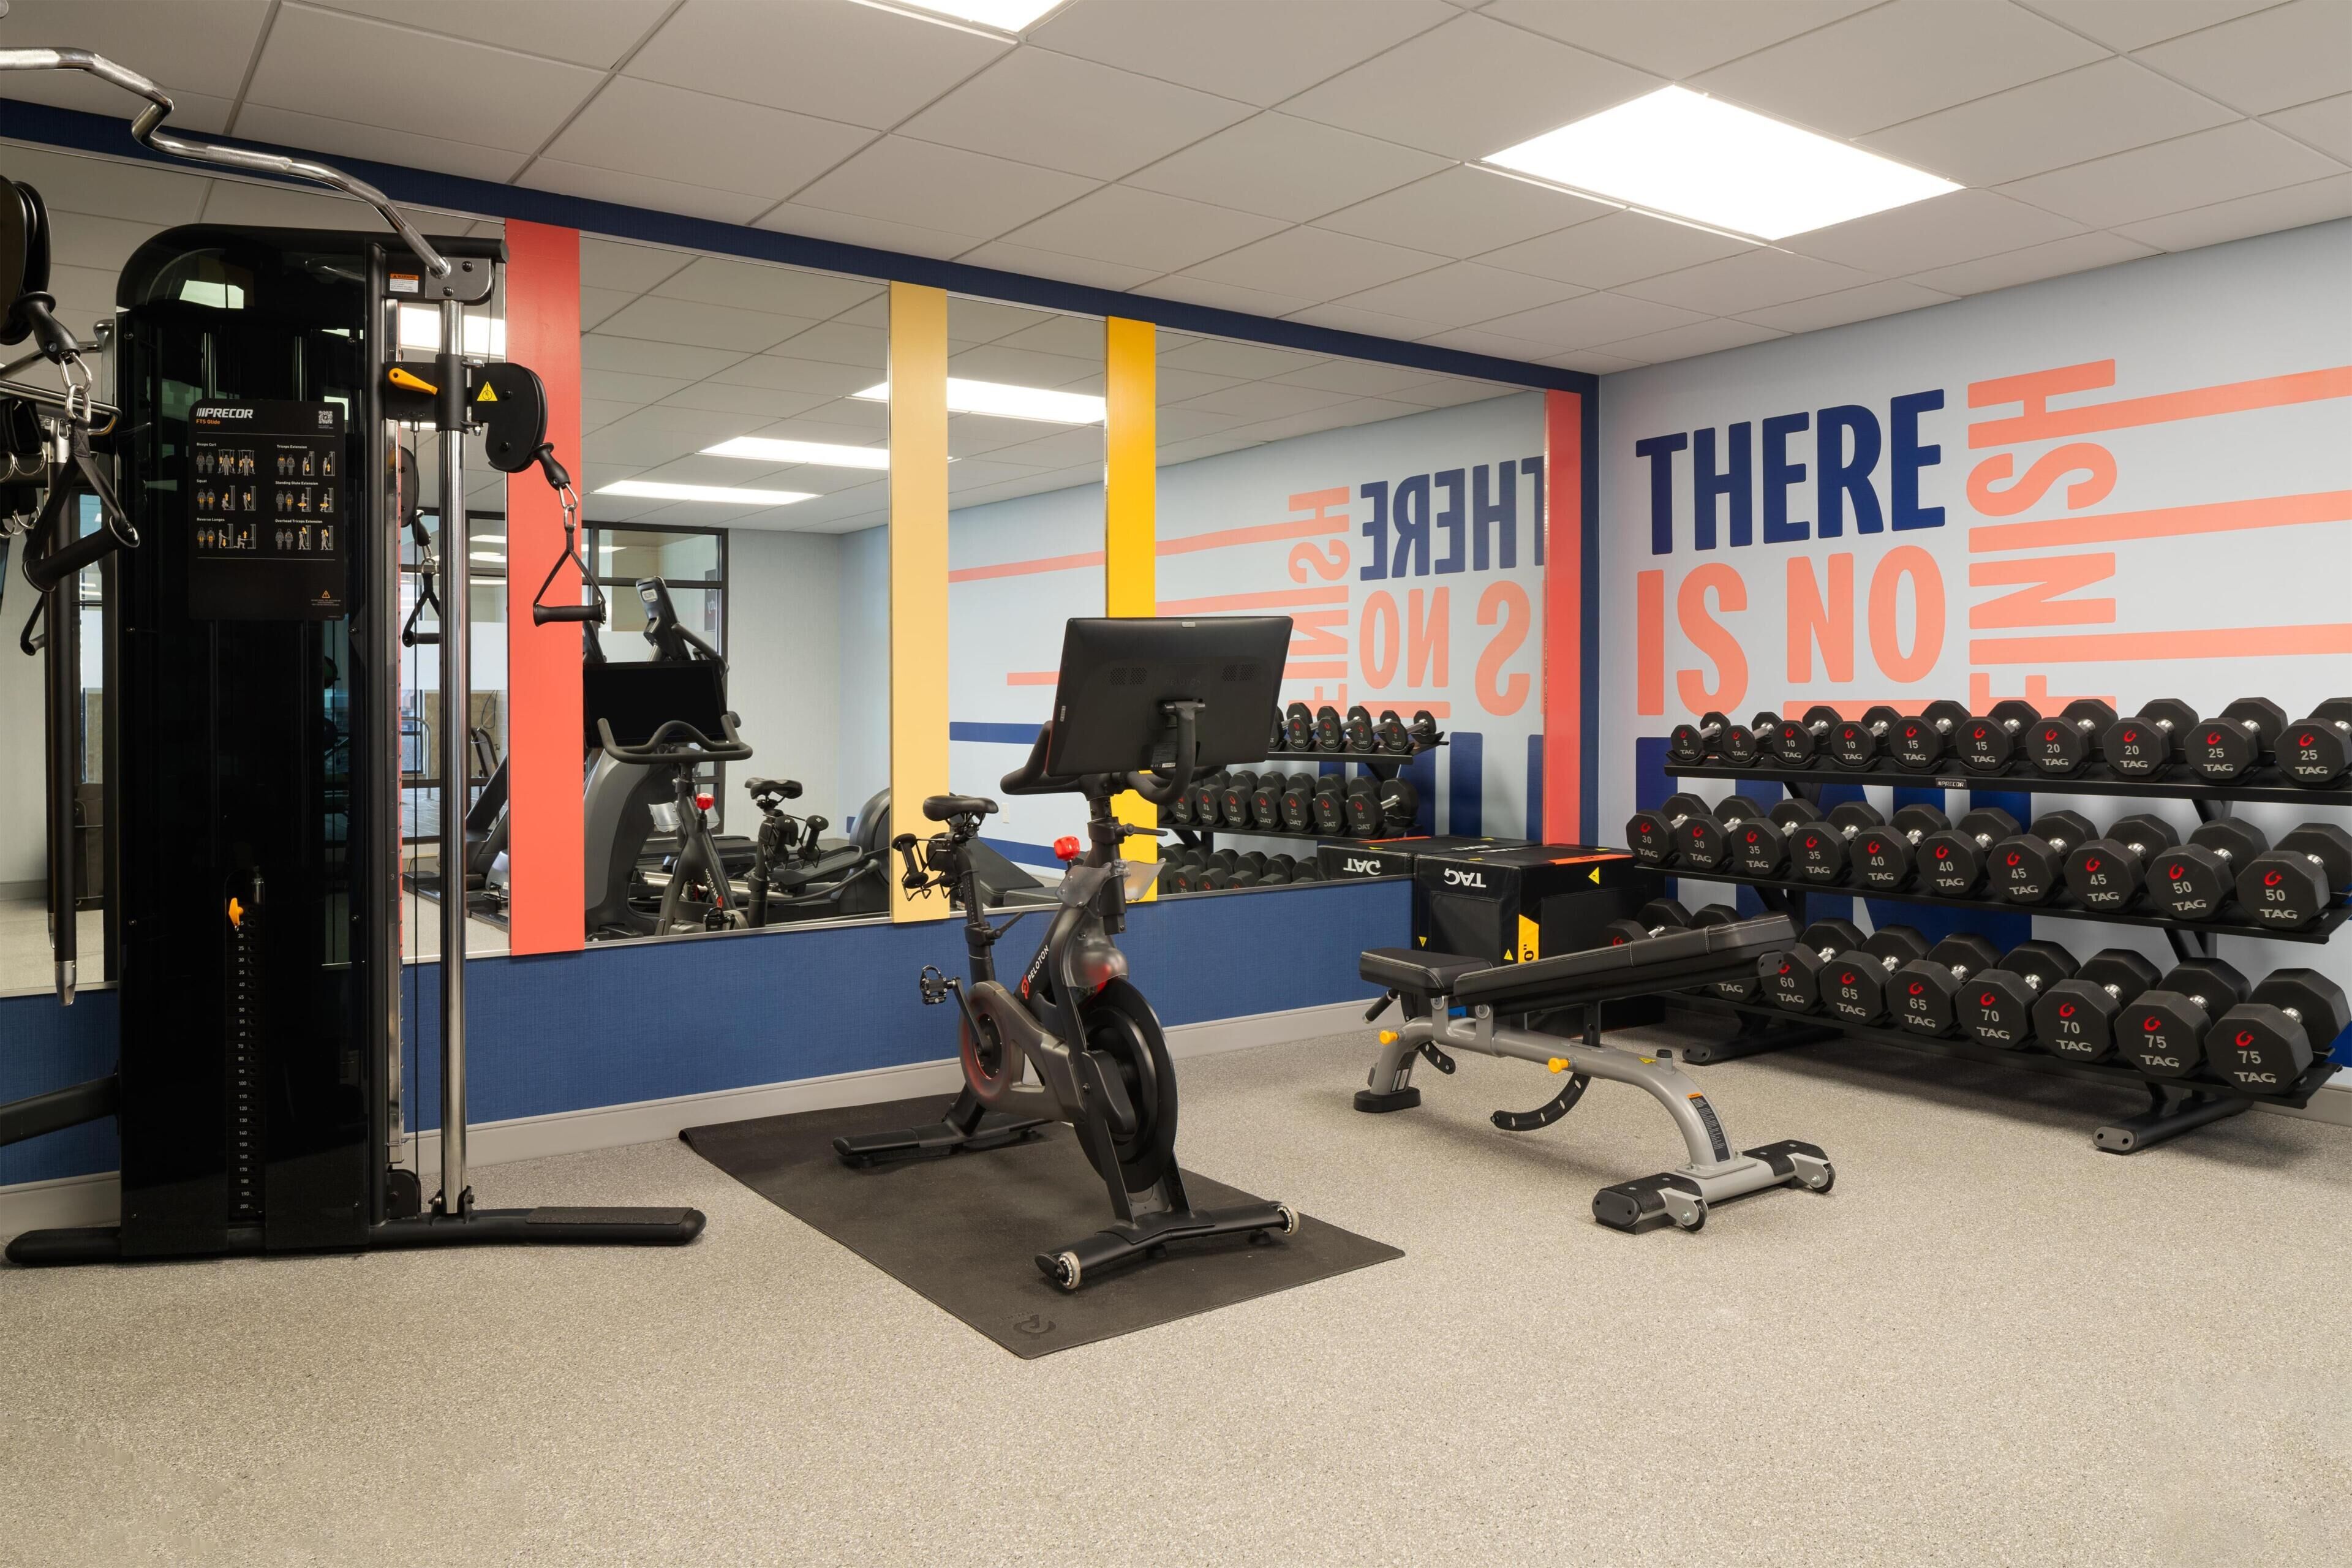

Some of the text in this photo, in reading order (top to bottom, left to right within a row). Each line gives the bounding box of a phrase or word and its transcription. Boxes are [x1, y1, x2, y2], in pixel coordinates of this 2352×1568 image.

[203, 407, 254, 419] PRECOR
[1636, 389, 1945, 555] THERE
[1967, 359, 2117, 717] FINISH
[1637, 545, 1945, 716] IS NO
[1846, 741, 1856, 749] 10
[1907, 740, 1918, 749] 15
[1975, 741, 1988, 750] 15
[2046, 744, 2060, 753] 20
[2125, 745, 2139, 755] 20
[2209, 748, 2224, 758] 25
[2301, 750, 2317, 760] 25
[2203, 763, 2234, 772] TAG
[2294, 766, 2328, 775] TAG
[1642, 835, 1652, 844] 30
[1694, 840, 1705, 849] 30
[1638, 848, 1657, 858] TAG
[1749, 845, 1760, 854] 35
[1691, 853, 1711, 862] TAG
[1808, 851, 1821, 860] 35
[1746, 860, 1769, 869] TAG
[1871, 857, 1884, 866] 40
[1805, 865, 1830, 874] TAG
[1939, 862, 1953, 872] 40
[1444, 868, 1487, 888] TAG
[1868, 872, 1894, 881] TAG
[2012, 869, 2026, 879] 45
[1936, 878, 1964, 887] TAG
[2090, 874, 2106, 885] 45
[2009, 885, 2038, 894] TAG
[2173, 881, 2192, 894] 50
[2087, 892, 2119, 901] TAG
[2266, 889, 2285, 901] 50
[2173, 900, 2206, 911] TAG
[2260, 909, 2297, 919] TAG
[1523, 944, 1534, 961] 0"
[1028, 945, 1049, 982] PELOTON
[1781, 977, 1794, 987] 60
[1718, 983, 1743, 993] TAG
[1777, 993, 1804, 1003] TAG
[1842, 987, 1858, 1000] 65
[1910, 998, 1926, 1010] 65
[1837, 1003, 1866, 1016] TAG
[1981, 1009, 1999, 1022] 70
[1904, 1014, 1936, 1028] TAG
[2060, 1020, 2079, 1033] 70
[1977, 1027, 2010, 1039] TAG
[2056, 1040, 2092, 1052] TAG
[2145, 1035, 2166, 1048] 75
[2140, 1055, 2179, 1067] TAG
[2237, 1051, 2261, 1063] 75
[2234, 1072, 2276, 1083] TAG
